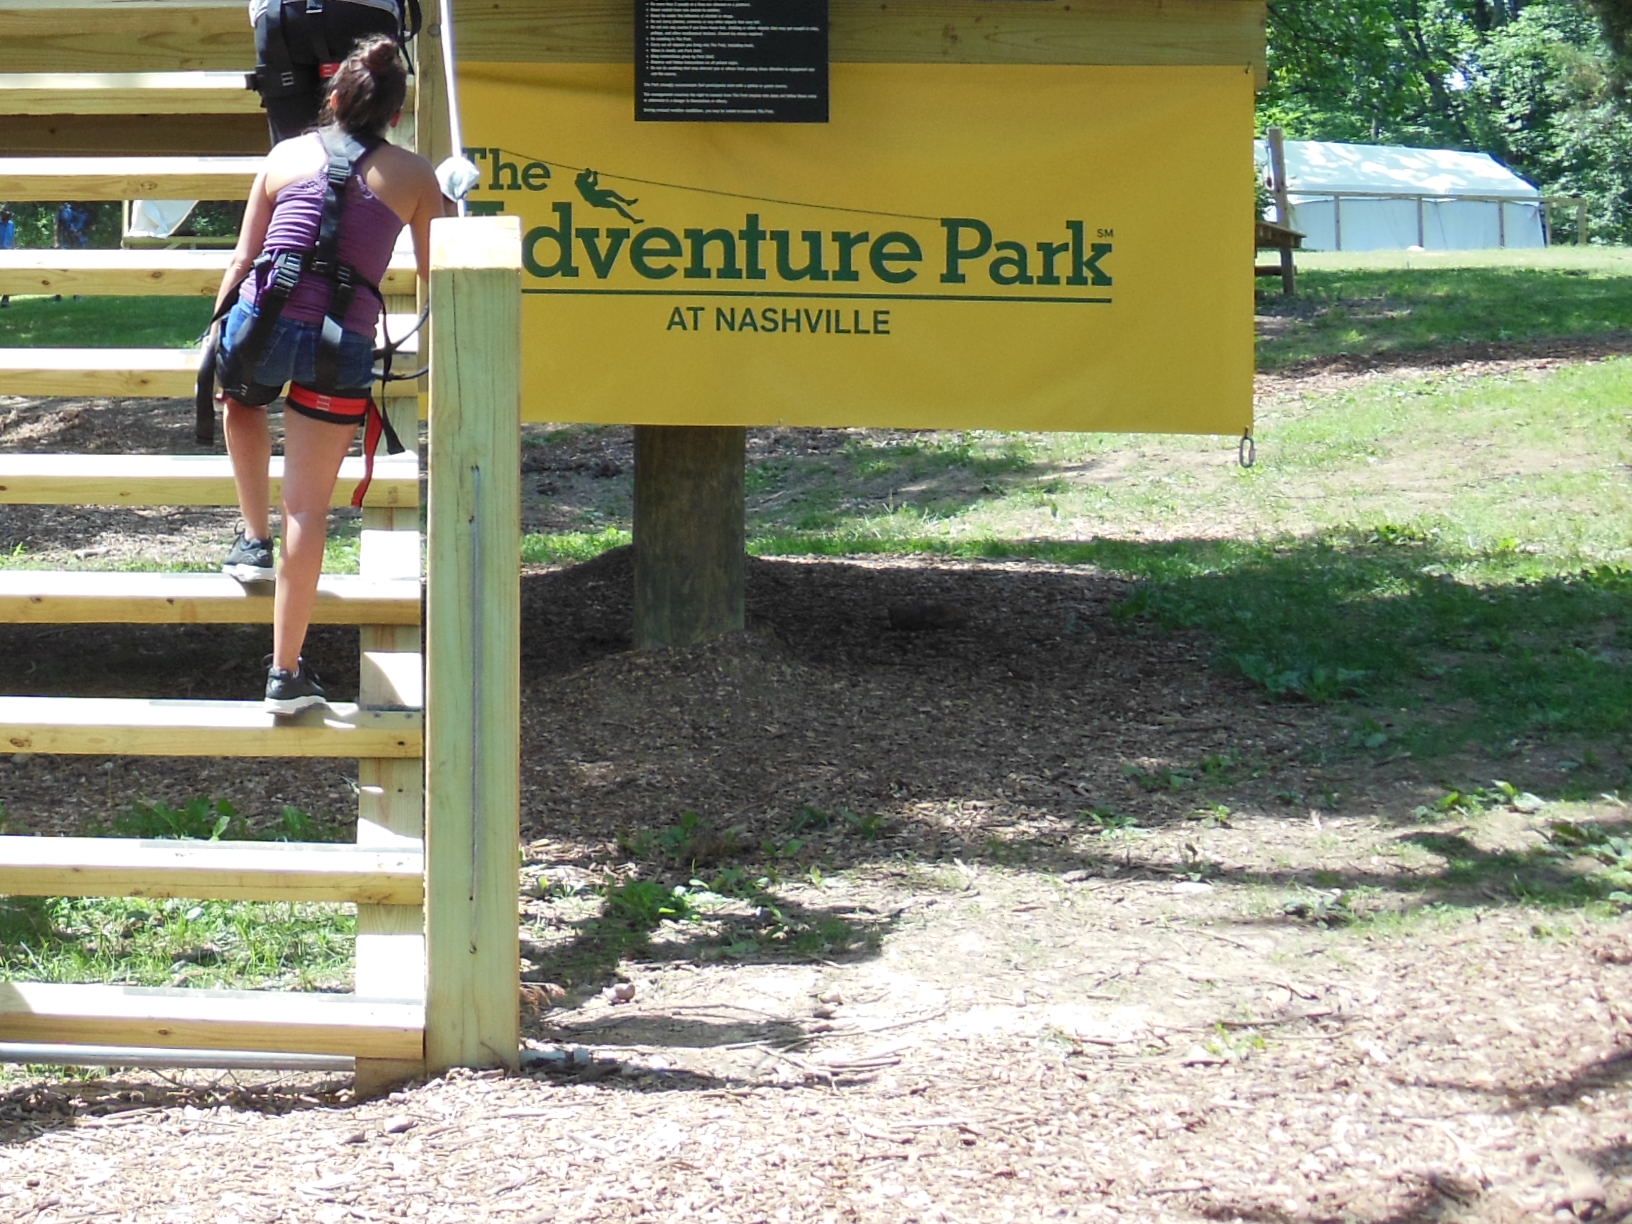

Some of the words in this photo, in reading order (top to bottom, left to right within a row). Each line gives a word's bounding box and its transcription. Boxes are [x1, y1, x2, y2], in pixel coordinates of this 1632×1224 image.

[462, 148, 551, 191] The
[465, 201, 925, 285] dventure
[940, 218, 1113, 287] Park
[1096, 228, 1114, 238] SM
[666, 307, 706, 334] AT
[715, 308, 891, 336] NASHVILLE
